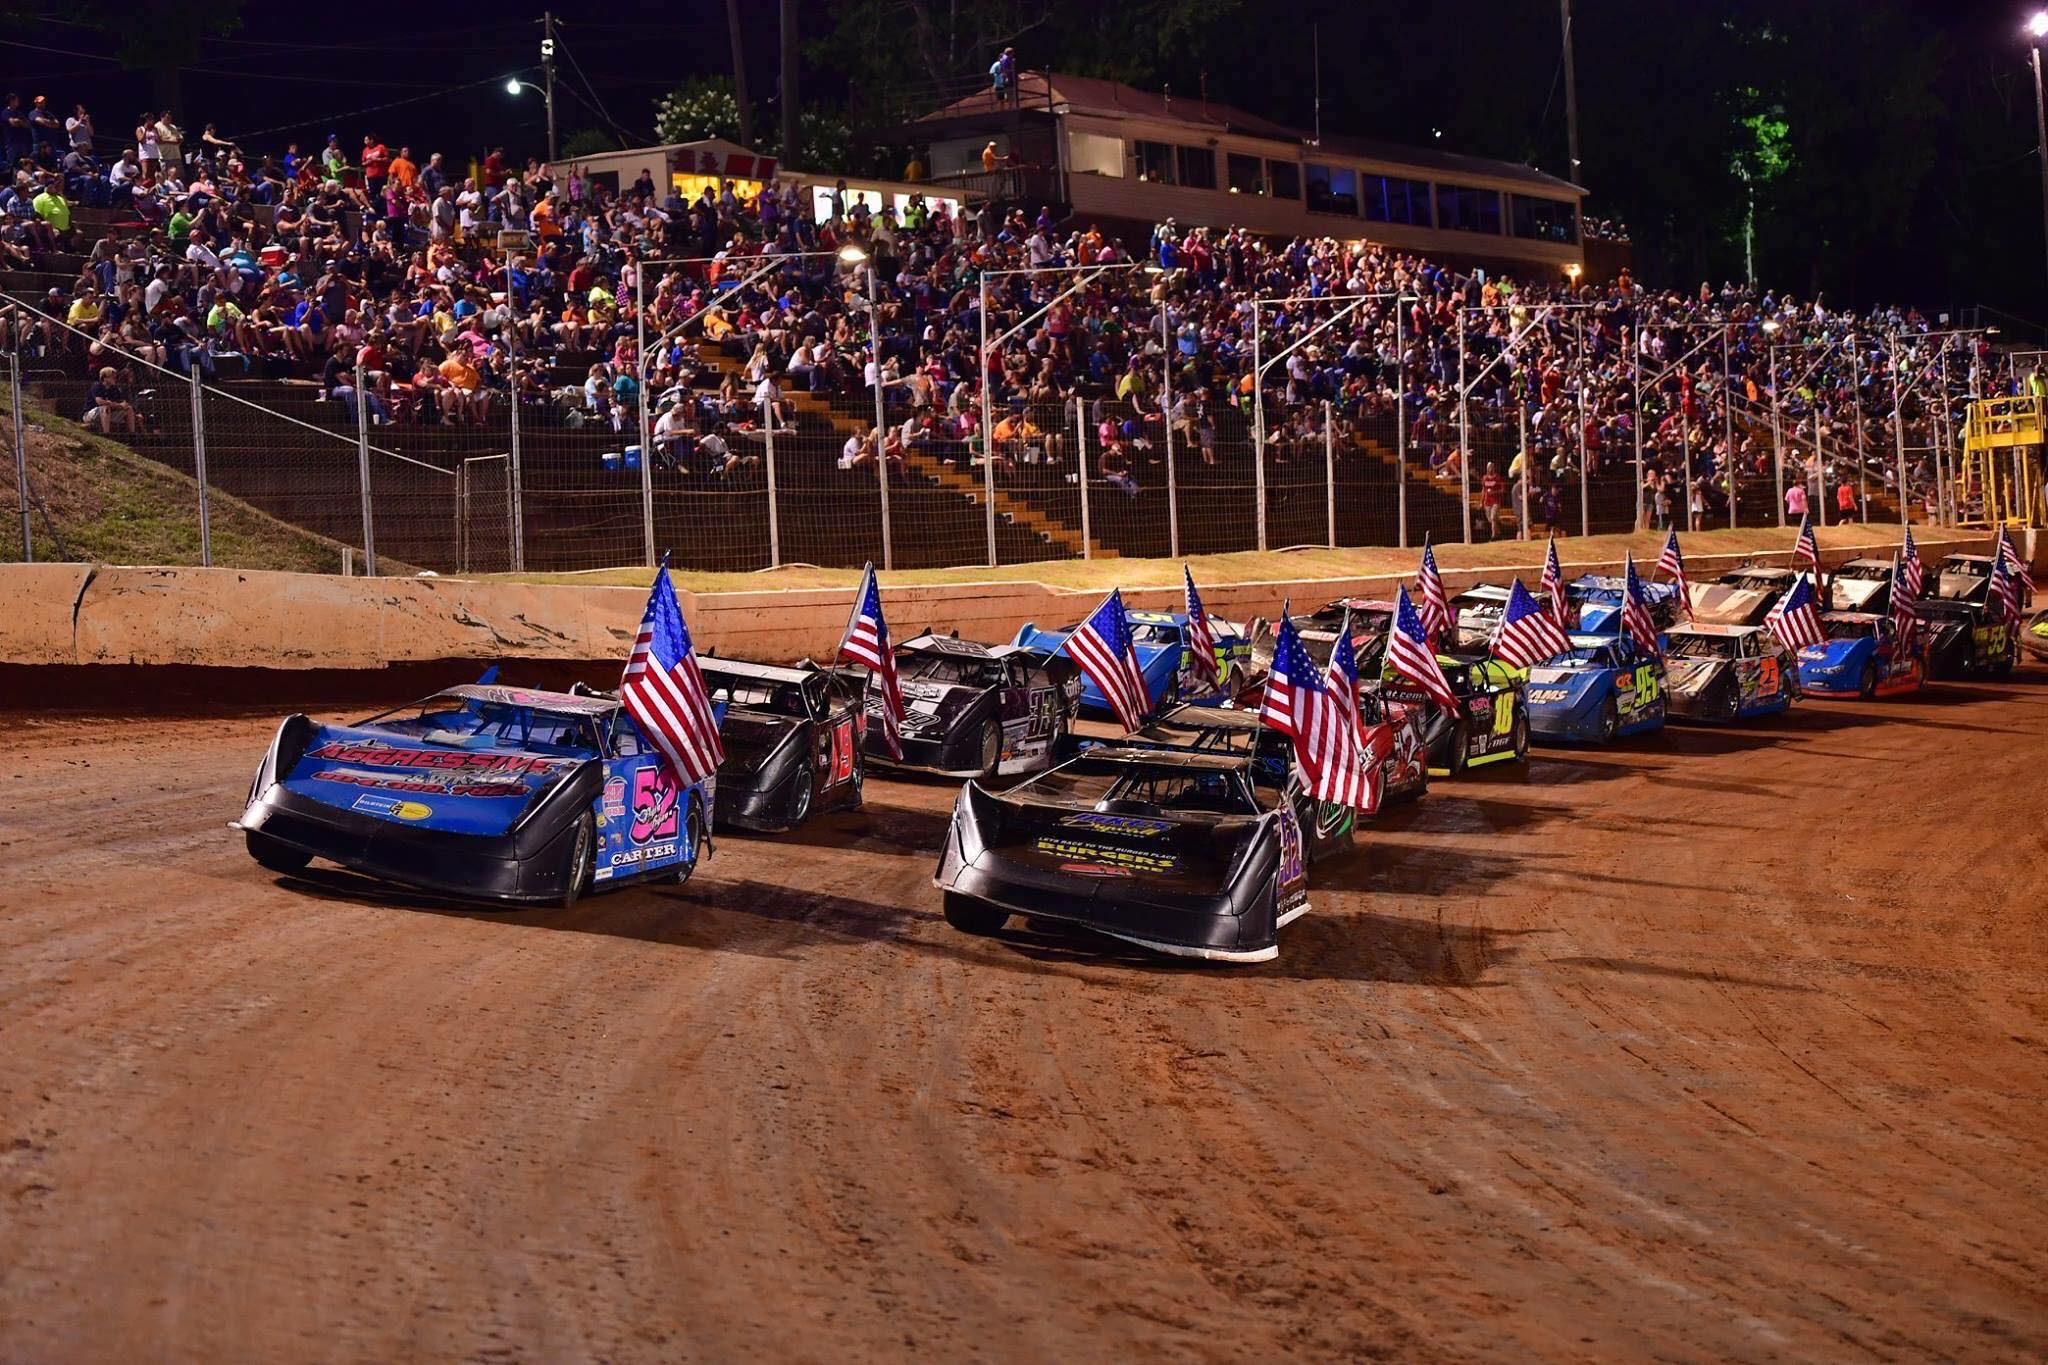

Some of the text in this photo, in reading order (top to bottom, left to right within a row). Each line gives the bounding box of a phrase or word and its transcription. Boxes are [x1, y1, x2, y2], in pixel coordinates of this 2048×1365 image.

[1634, 664, 1659, 708] 95
[629, 765, 680, 846] 52
[611, 843, 677, 867] CARTER
[1037, 841, 1174, 868] BURGERS
